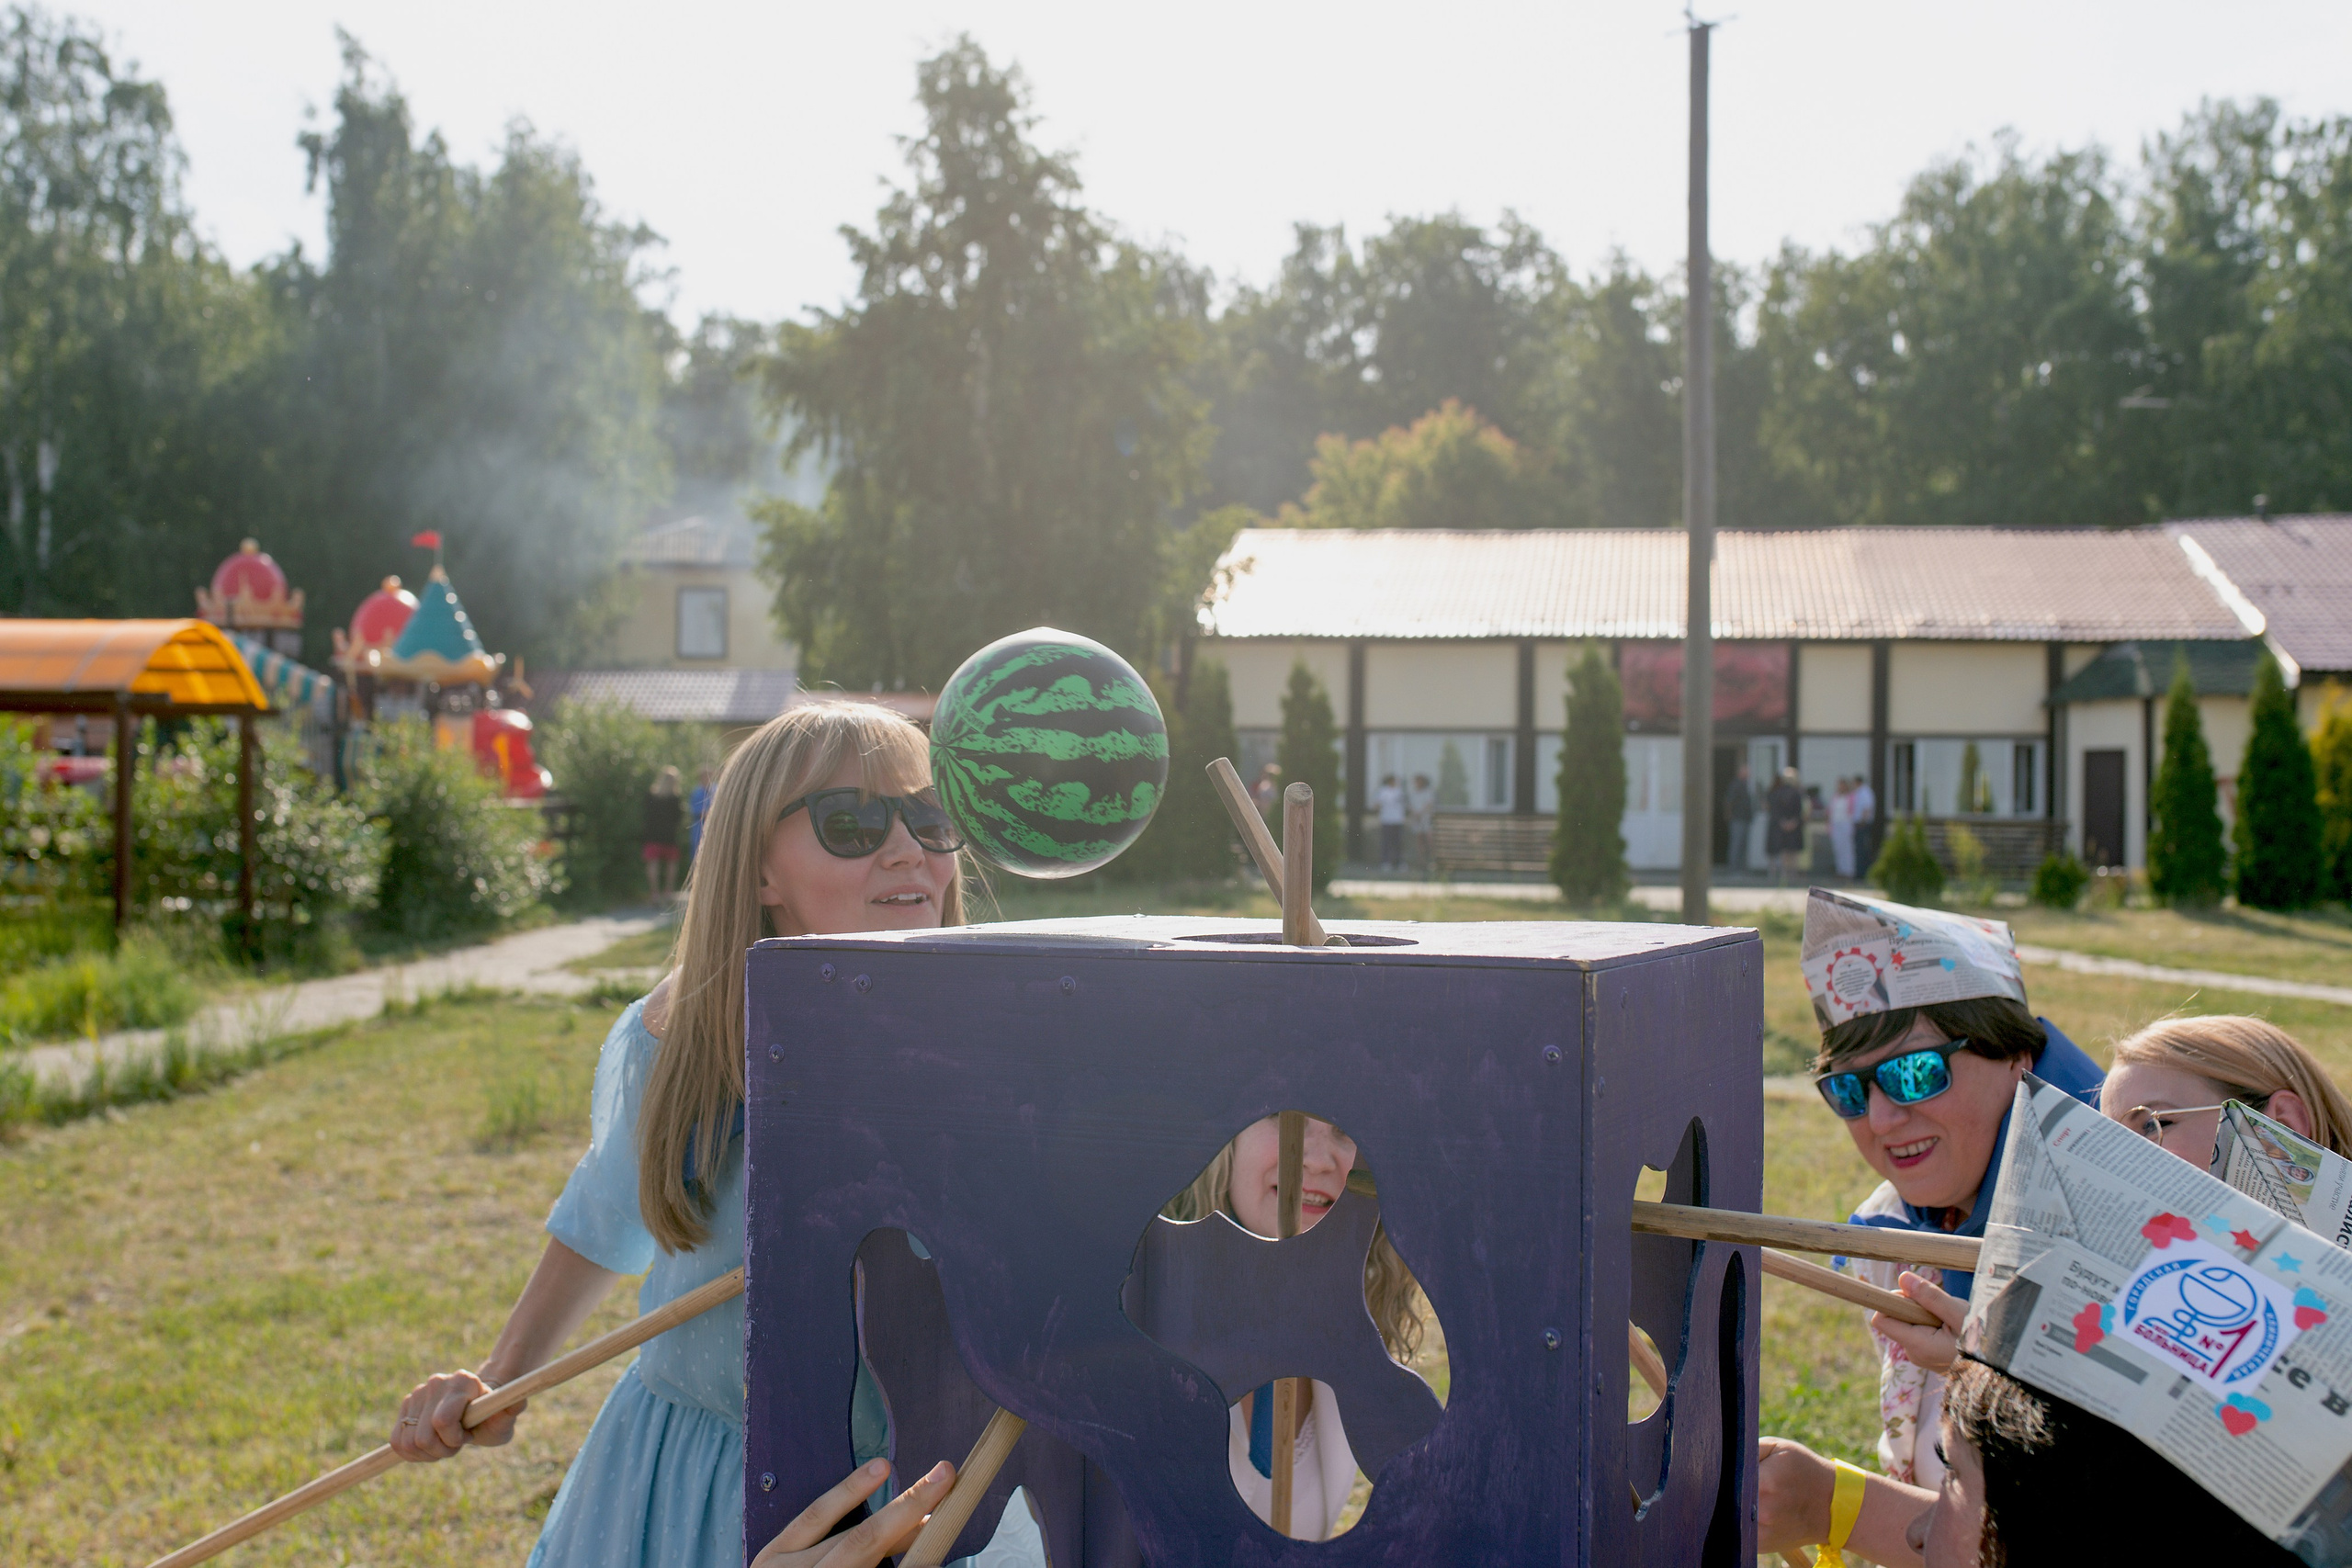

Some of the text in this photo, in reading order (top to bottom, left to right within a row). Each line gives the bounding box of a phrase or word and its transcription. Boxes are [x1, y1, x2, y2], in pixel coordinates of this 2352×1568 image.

[2329, 1181, 2343, 1210] участие
[2069, 1260, 2111, 1288] Будут
[2127, 1262, 2181, 1311] ГОРОДСКАЯ
[2133, 1324, 2209, 1373] БОЛЬНИЦА
[2233, 1312, 2278, 1379] КЛИНИЧЕСКАЯ
